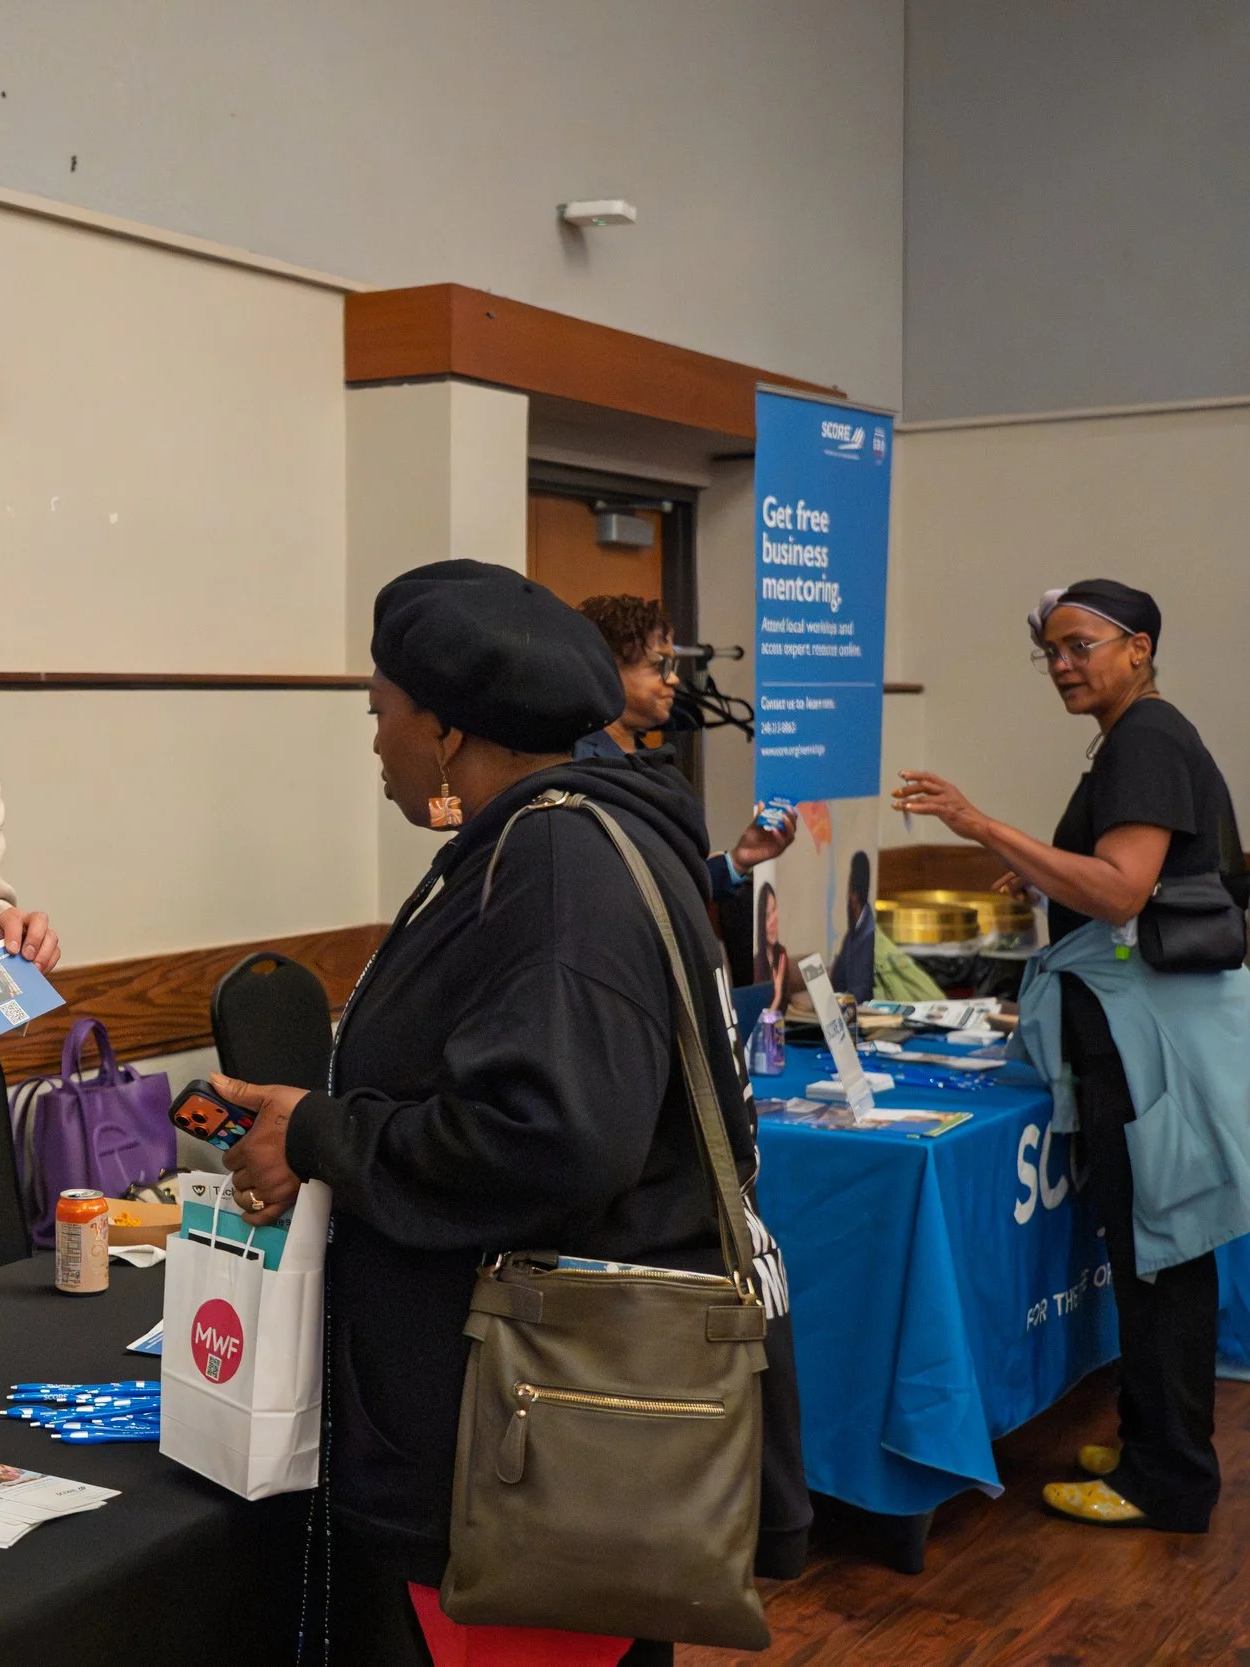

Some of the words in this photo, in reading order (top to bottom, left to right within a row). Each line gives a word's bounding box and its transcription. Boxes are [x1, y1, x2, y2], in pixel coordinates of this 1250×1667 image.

[821, 421, 851, 442] SCORE
[762, 495, 793, 530] Get
[796, 499, 830, 533] free
[762, 531, 829, 569] business
[786, 618, 805, 634] local
[838, 620, 855, 636] and
[784, 643, 811, 660] expert
[761, 696, 786, 711] Contact
[796, 698, 805, 711] to
[1026, 1298, 1048, 1333] FOR
[195, 1322, 240, 1360] MWF
